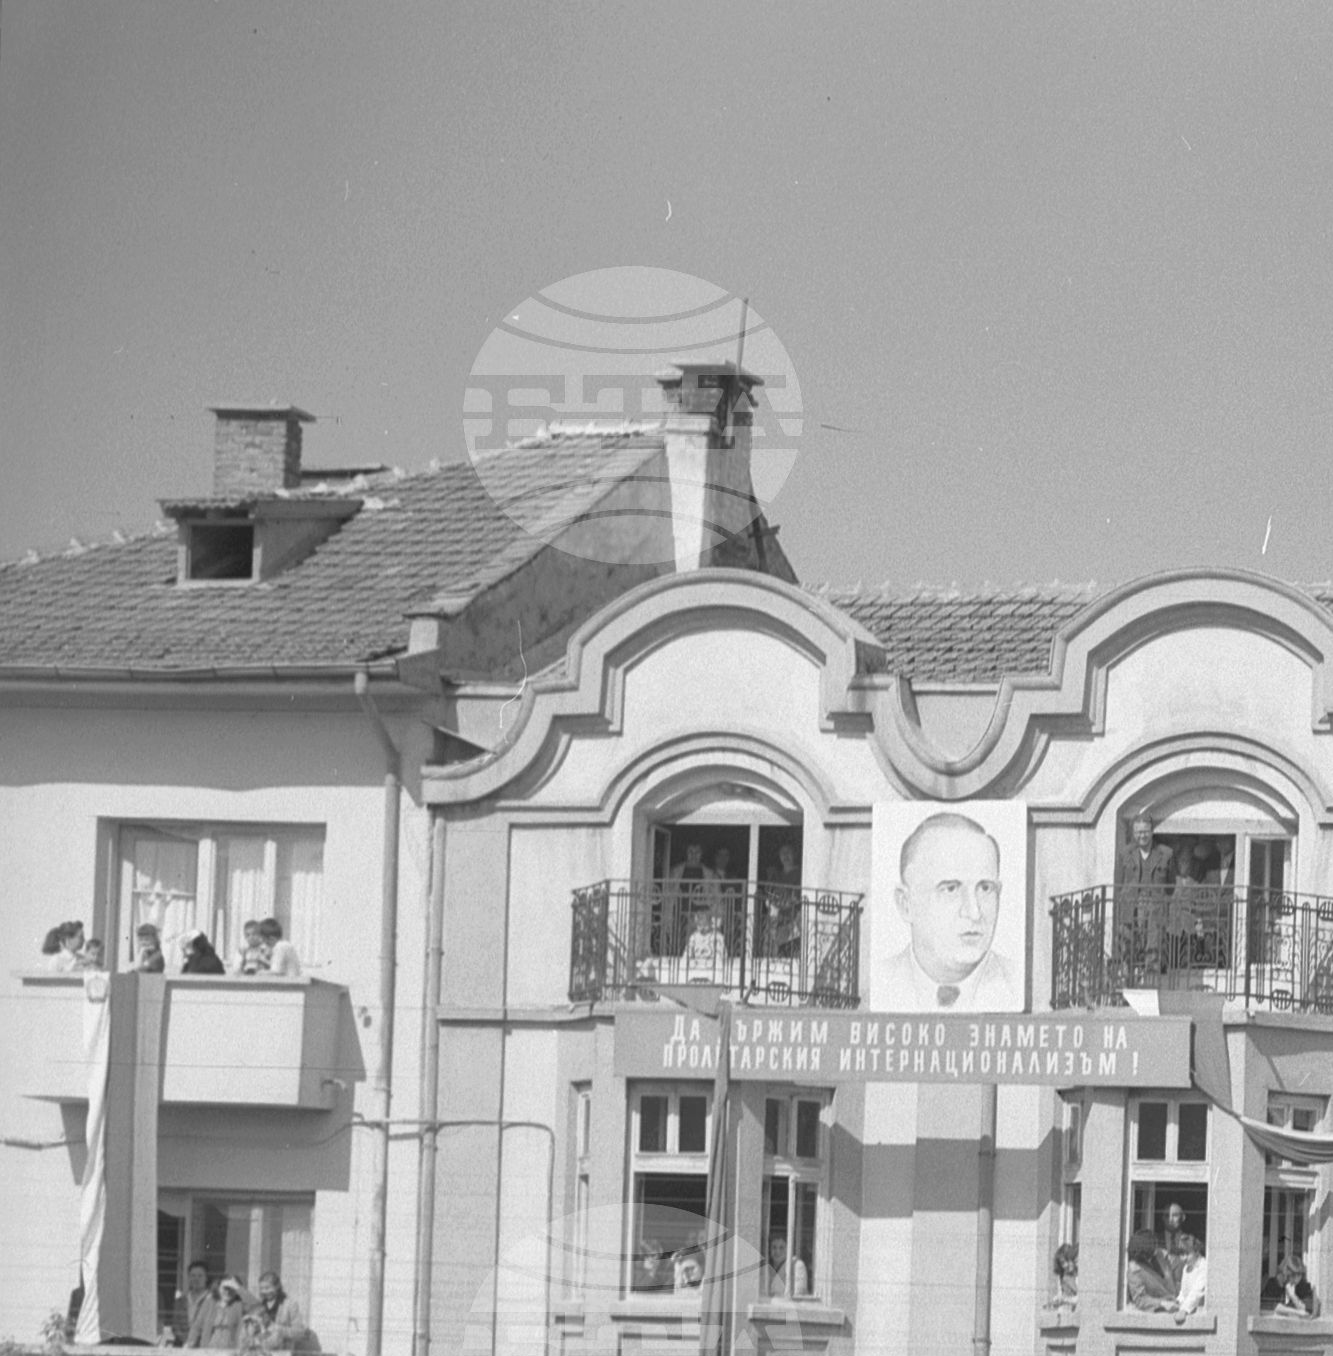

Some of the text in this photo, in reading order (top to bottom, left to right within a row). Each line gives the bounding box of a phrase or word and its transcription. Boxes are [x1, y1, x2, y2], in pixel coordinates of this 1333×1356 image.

[670, 1014, 1128, 1049] ДА ЪРЖИМ ВИСОКО ЗНАМЕТО НА
[839, 1047, 1117, 1077] ИНТЕРНАЦИОНАЛИЗЪМ
